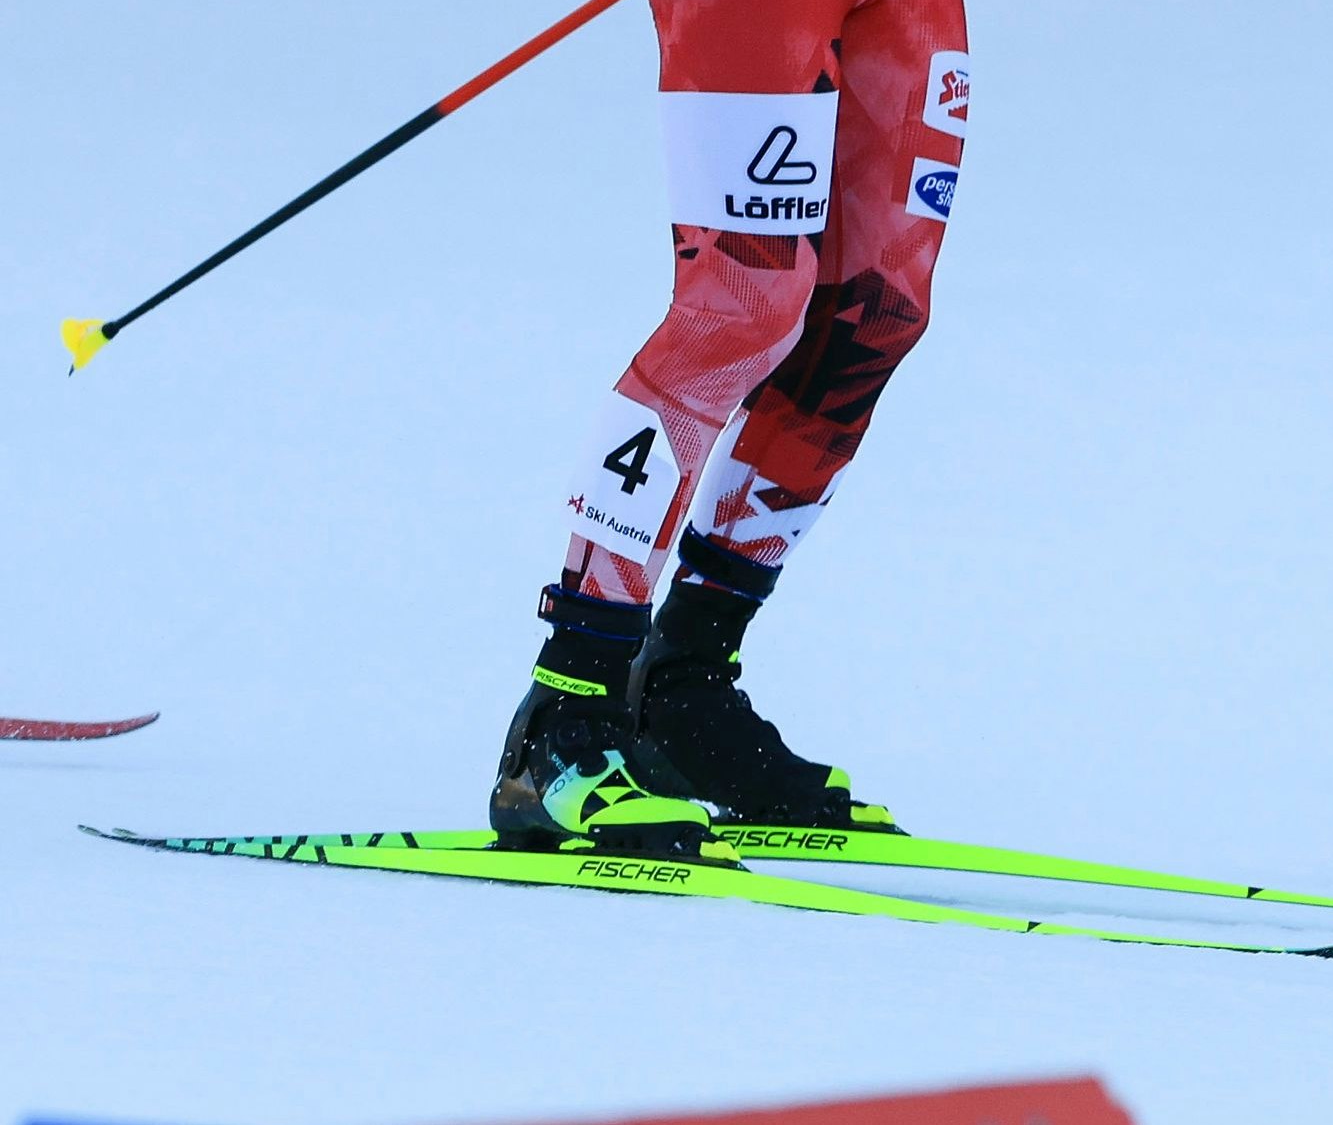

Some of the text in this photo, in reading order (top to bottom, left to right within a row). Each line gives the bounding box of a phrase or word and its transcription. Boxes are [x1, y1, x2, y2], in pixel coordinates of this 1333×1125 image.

[603, 427, 657, 495] 4
[585, 506, 651, 544] Ski Austria
[535, 671, 599, 696] FISCHER
[577, 861, 691, 885] FISCHER
